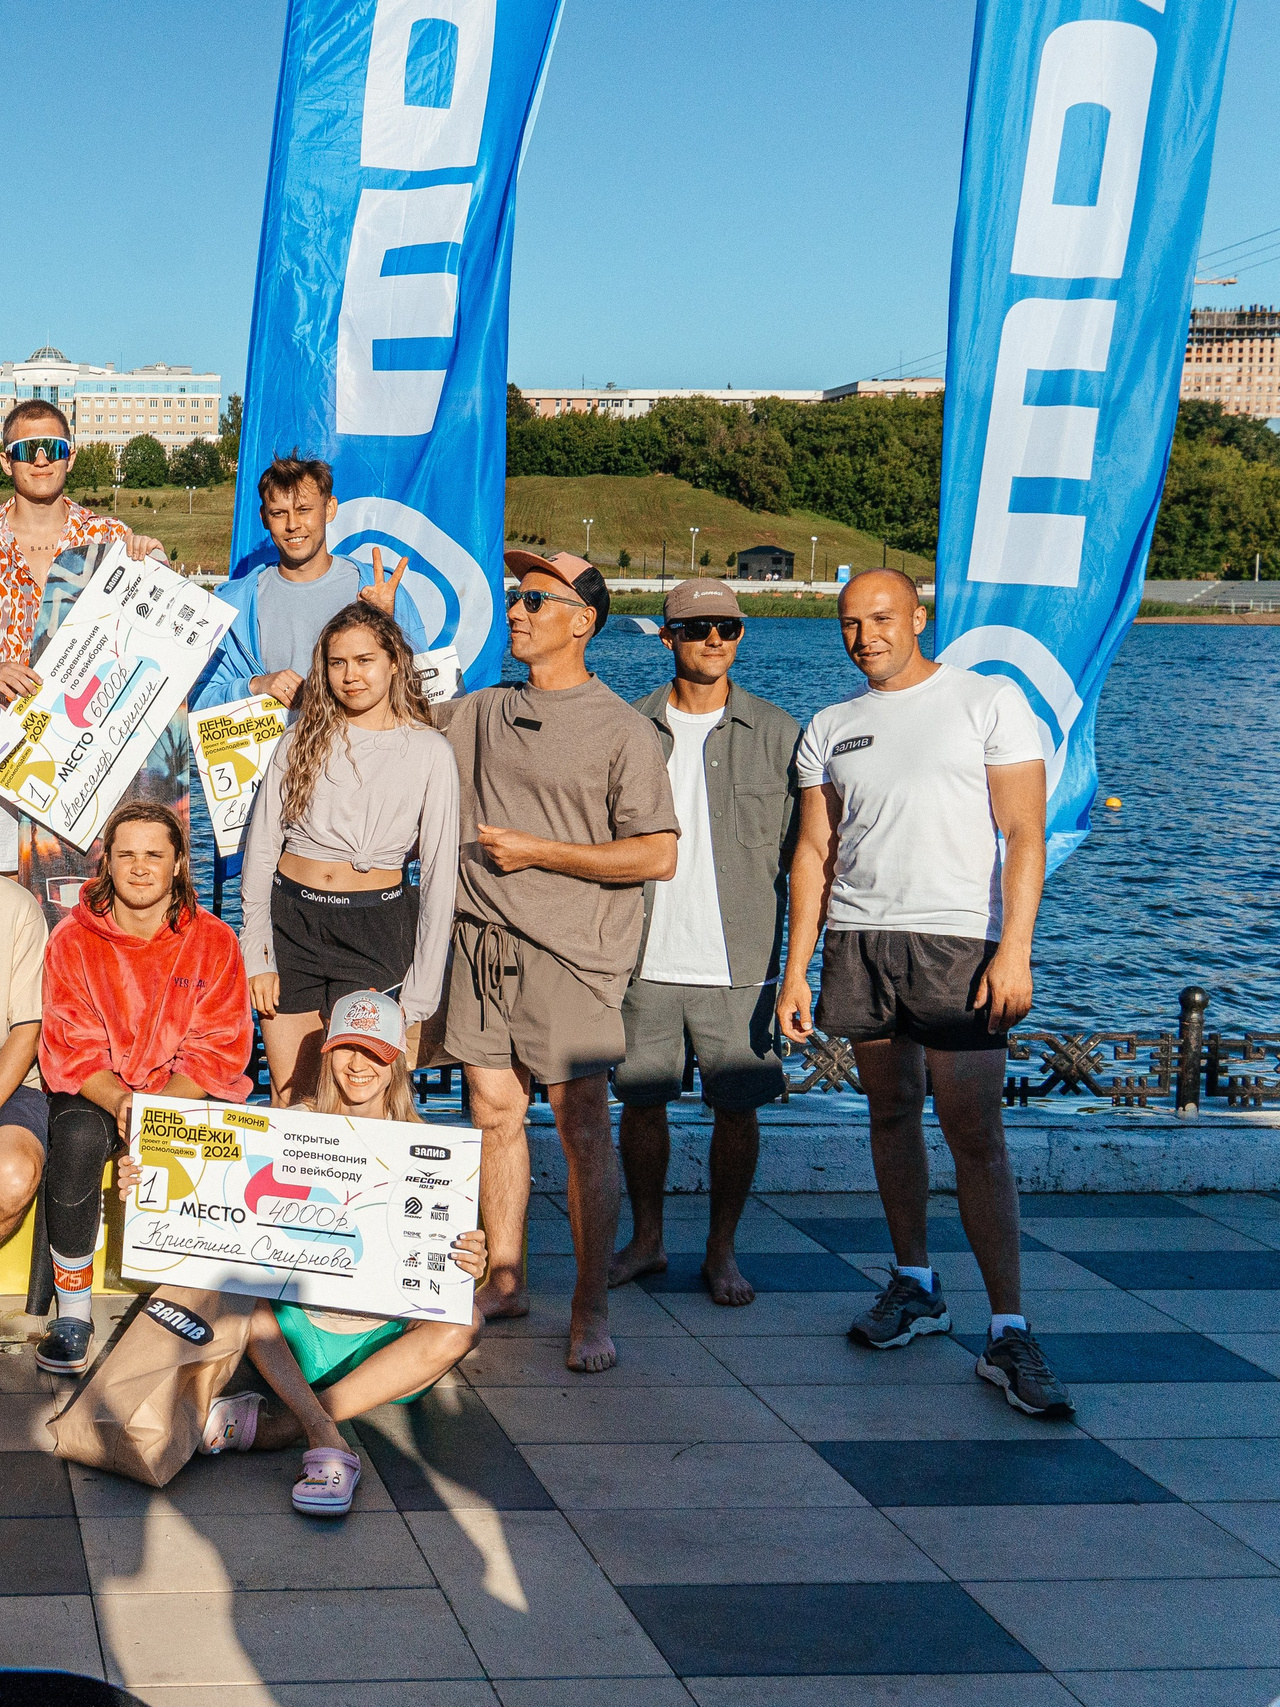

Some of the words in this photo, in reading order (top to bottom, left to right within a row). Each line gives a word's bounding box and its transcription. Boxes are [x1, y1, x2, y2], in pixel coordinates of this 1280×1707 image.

[50, 638, 78, 678] открытые
[60, 625, 100, 684] соревнования
[70, 678, 80, 691] по
[78, 634, 109, 679] вейкборду
[16, 703, 24, 712] 29
[29, 713, 50, 742] 2024
[199, 717, 232, 734] ДЕНЬ
[202, 716, 275, 743] МОЛОДЁЖИ
[254, 725, 284, 742] 2024
[834, 737, 869, 755] залив
[58, 732, 94, 783] МЕСТО
[215, 768, 232, 792] 3
[29, 782, 51, 809] 1
[300, 889, 326, 903] Calvin
[327, 896, 350, 905] Klein
[381, 889, 401, 901] Calvin
[144, 1110, 183, 1125] ДЕНЬ
[226, 1113, 237, 1122] 29
[238, 1114, 265, 1128] ИЮНЯ
[143, 1124, 233, 1145] МОЛОДЁЖИ
[284, 1132, 340, 1146] открытые
[141, 1145, 195, 1157] росмолодёжь
[204, 1145, 239, 1159] 2024
[283, 1149, 367, 1166] соревнования
[414, 1146, 446, 1159] ЗАЛИВ
[282, 1165, 296, 1174] по
[300, 1165, 362, 1183] вейкборду
[405, 1175, 450, 1186] RECORD
[140, 1172, 157, 1204] 1
[180, 1202, 246, 1224] МЕСТО
[430, 1211, 449, 1222] KUSTO
[139, 1220, 246, 1255] Кристина
[251, 1236, 357, 1272] Смирнова
[147, 1301, 205, 1339] ЗАЛИВ
